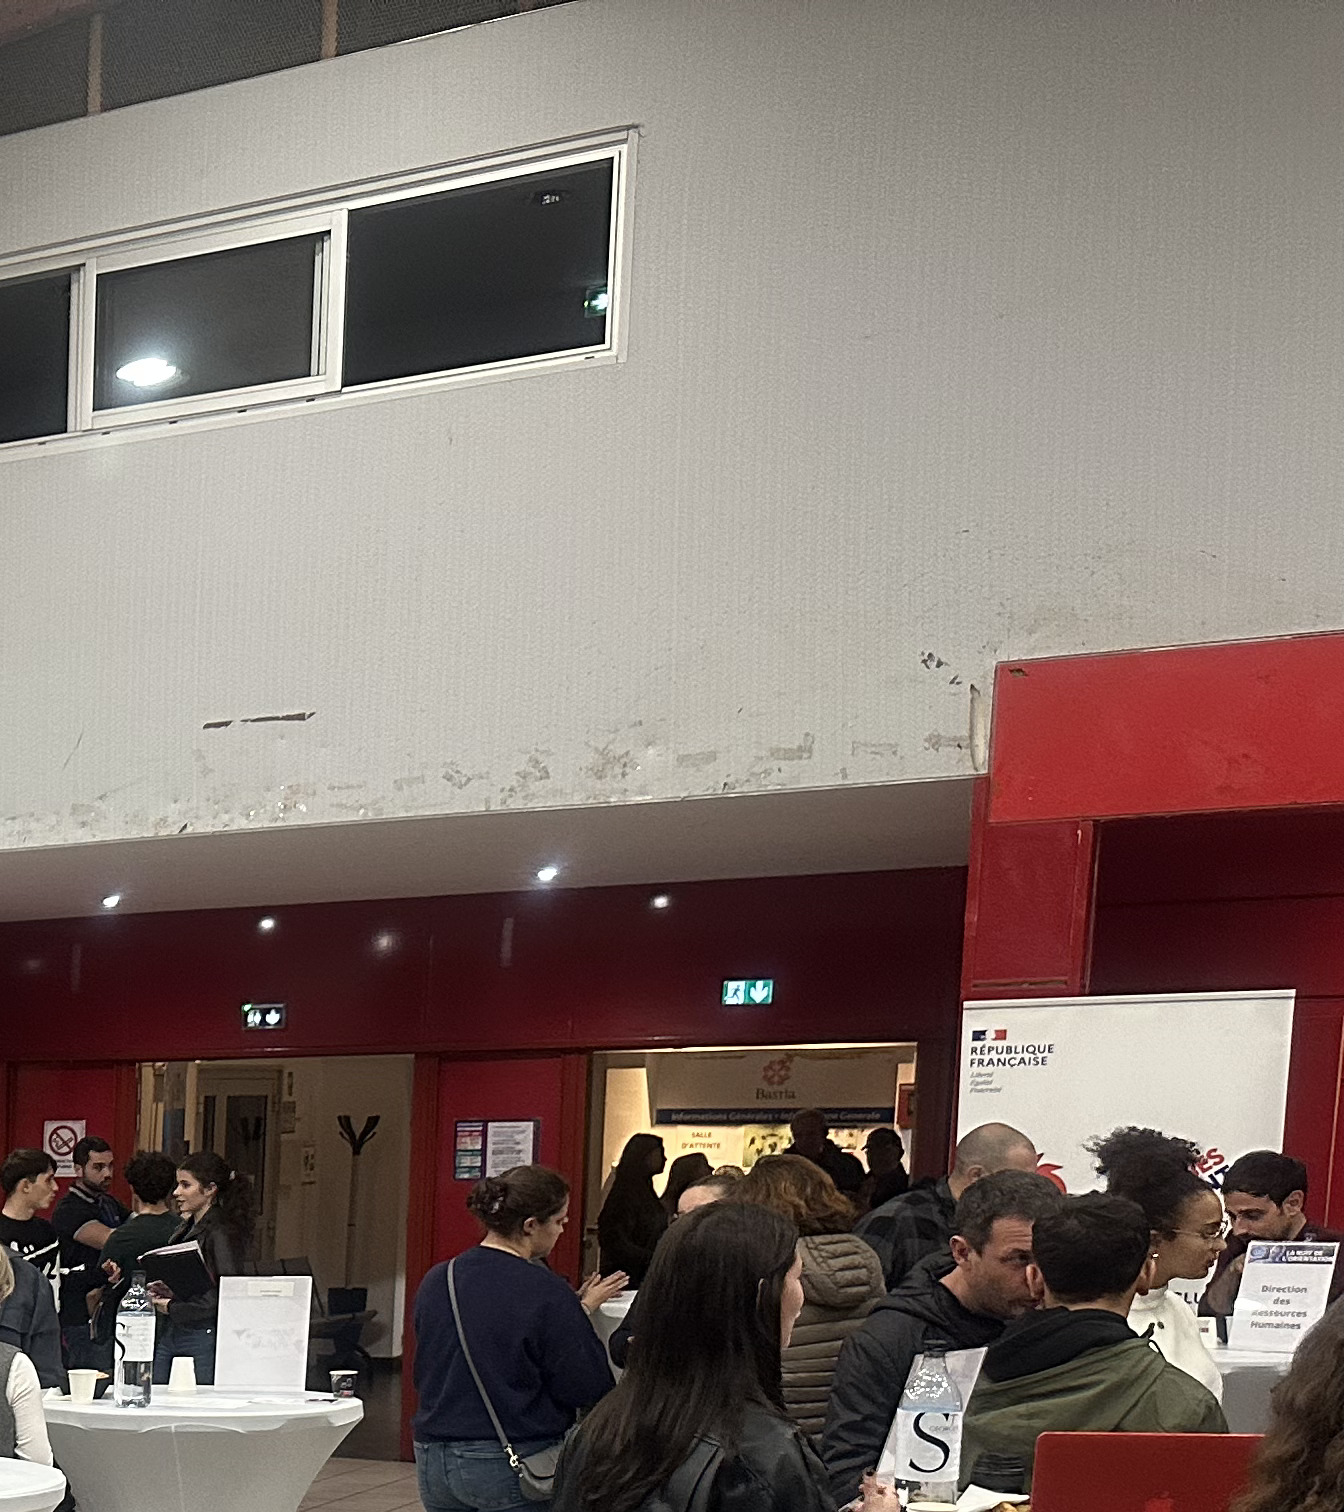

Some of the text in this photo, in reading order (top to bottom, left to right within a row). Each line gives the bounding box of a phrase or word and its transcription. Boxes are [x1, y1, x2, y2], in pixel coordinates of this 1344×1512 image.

[970, 1044, 1054, 1055] RÉPUBLIQUE
[970, 1056, 1048, 1068] FRANÇAISE
[1261, 1285, 1307, 1294] Direction
[1273, 1297, 1290, 1305] des
[1250, 1321, 1301, 1330] Humaines
